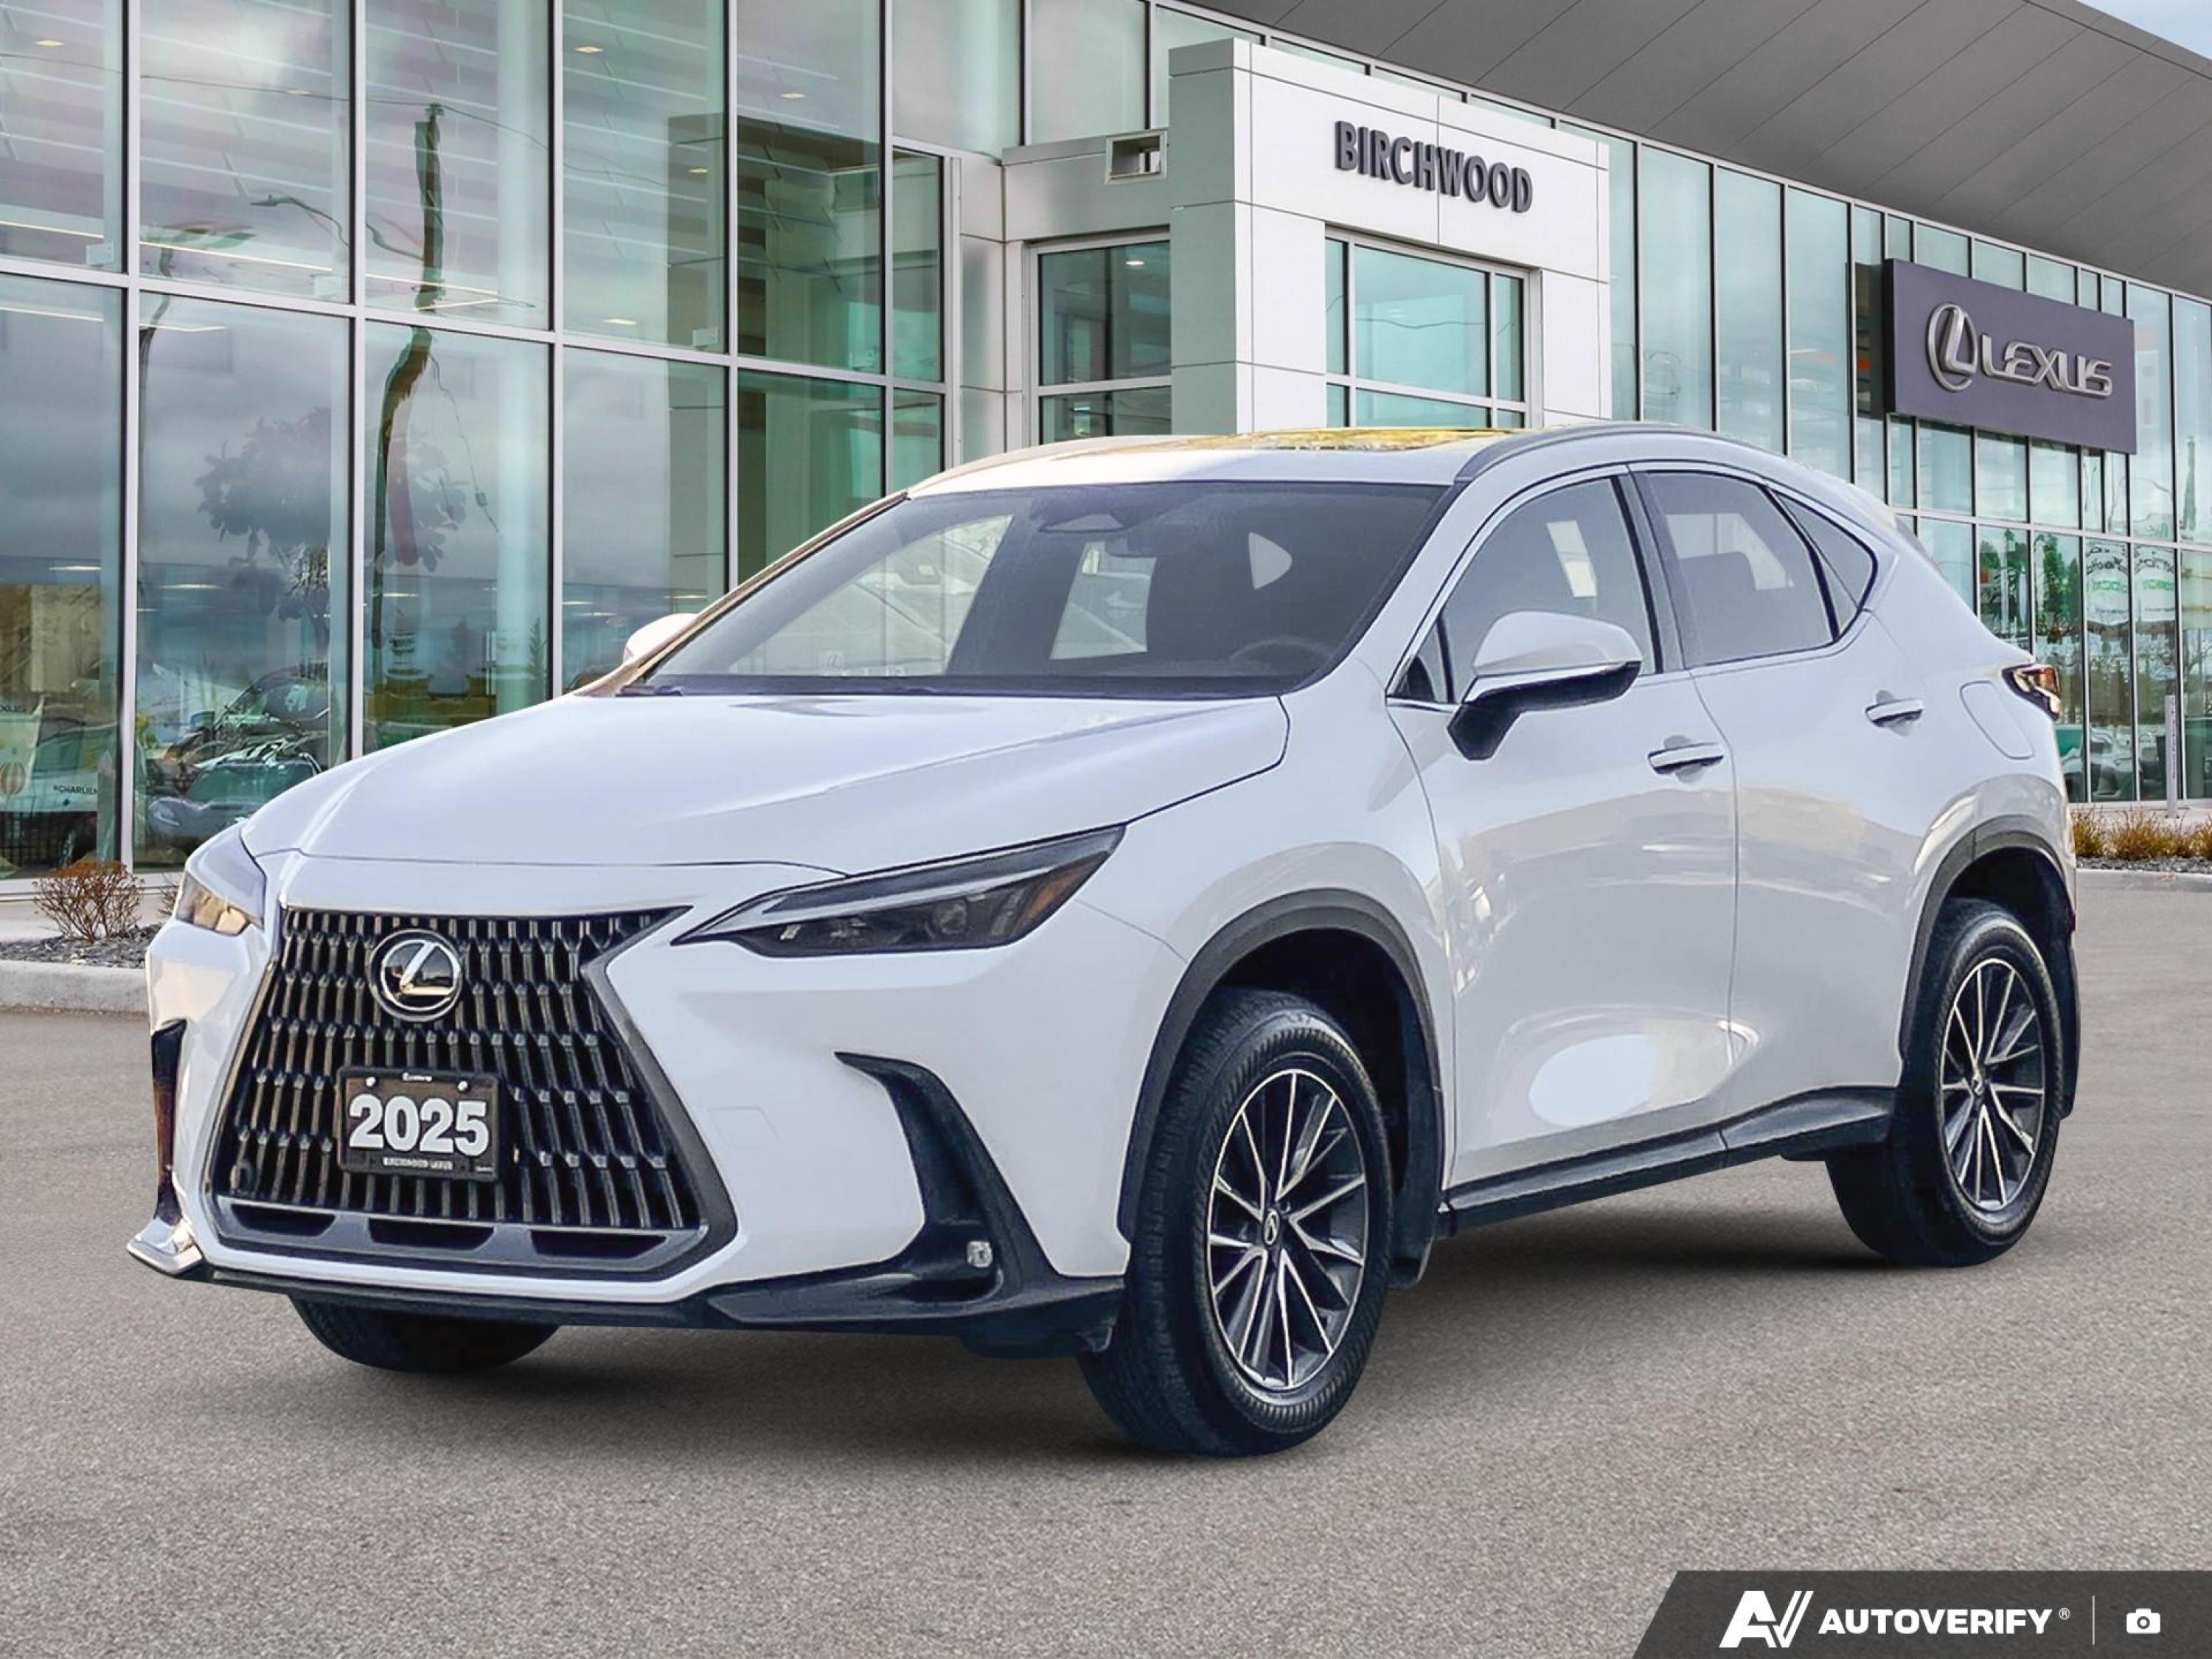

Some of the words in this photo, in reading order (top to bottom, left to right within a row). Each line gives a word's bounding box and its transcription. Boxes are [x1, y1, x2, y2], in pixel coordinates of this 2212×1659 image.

[1335, 120, 1534, 213] BIRCHWOOD
[1981, 333, 2112, 398] LEXUS
[349, 1093, 490, 1157] 2025
